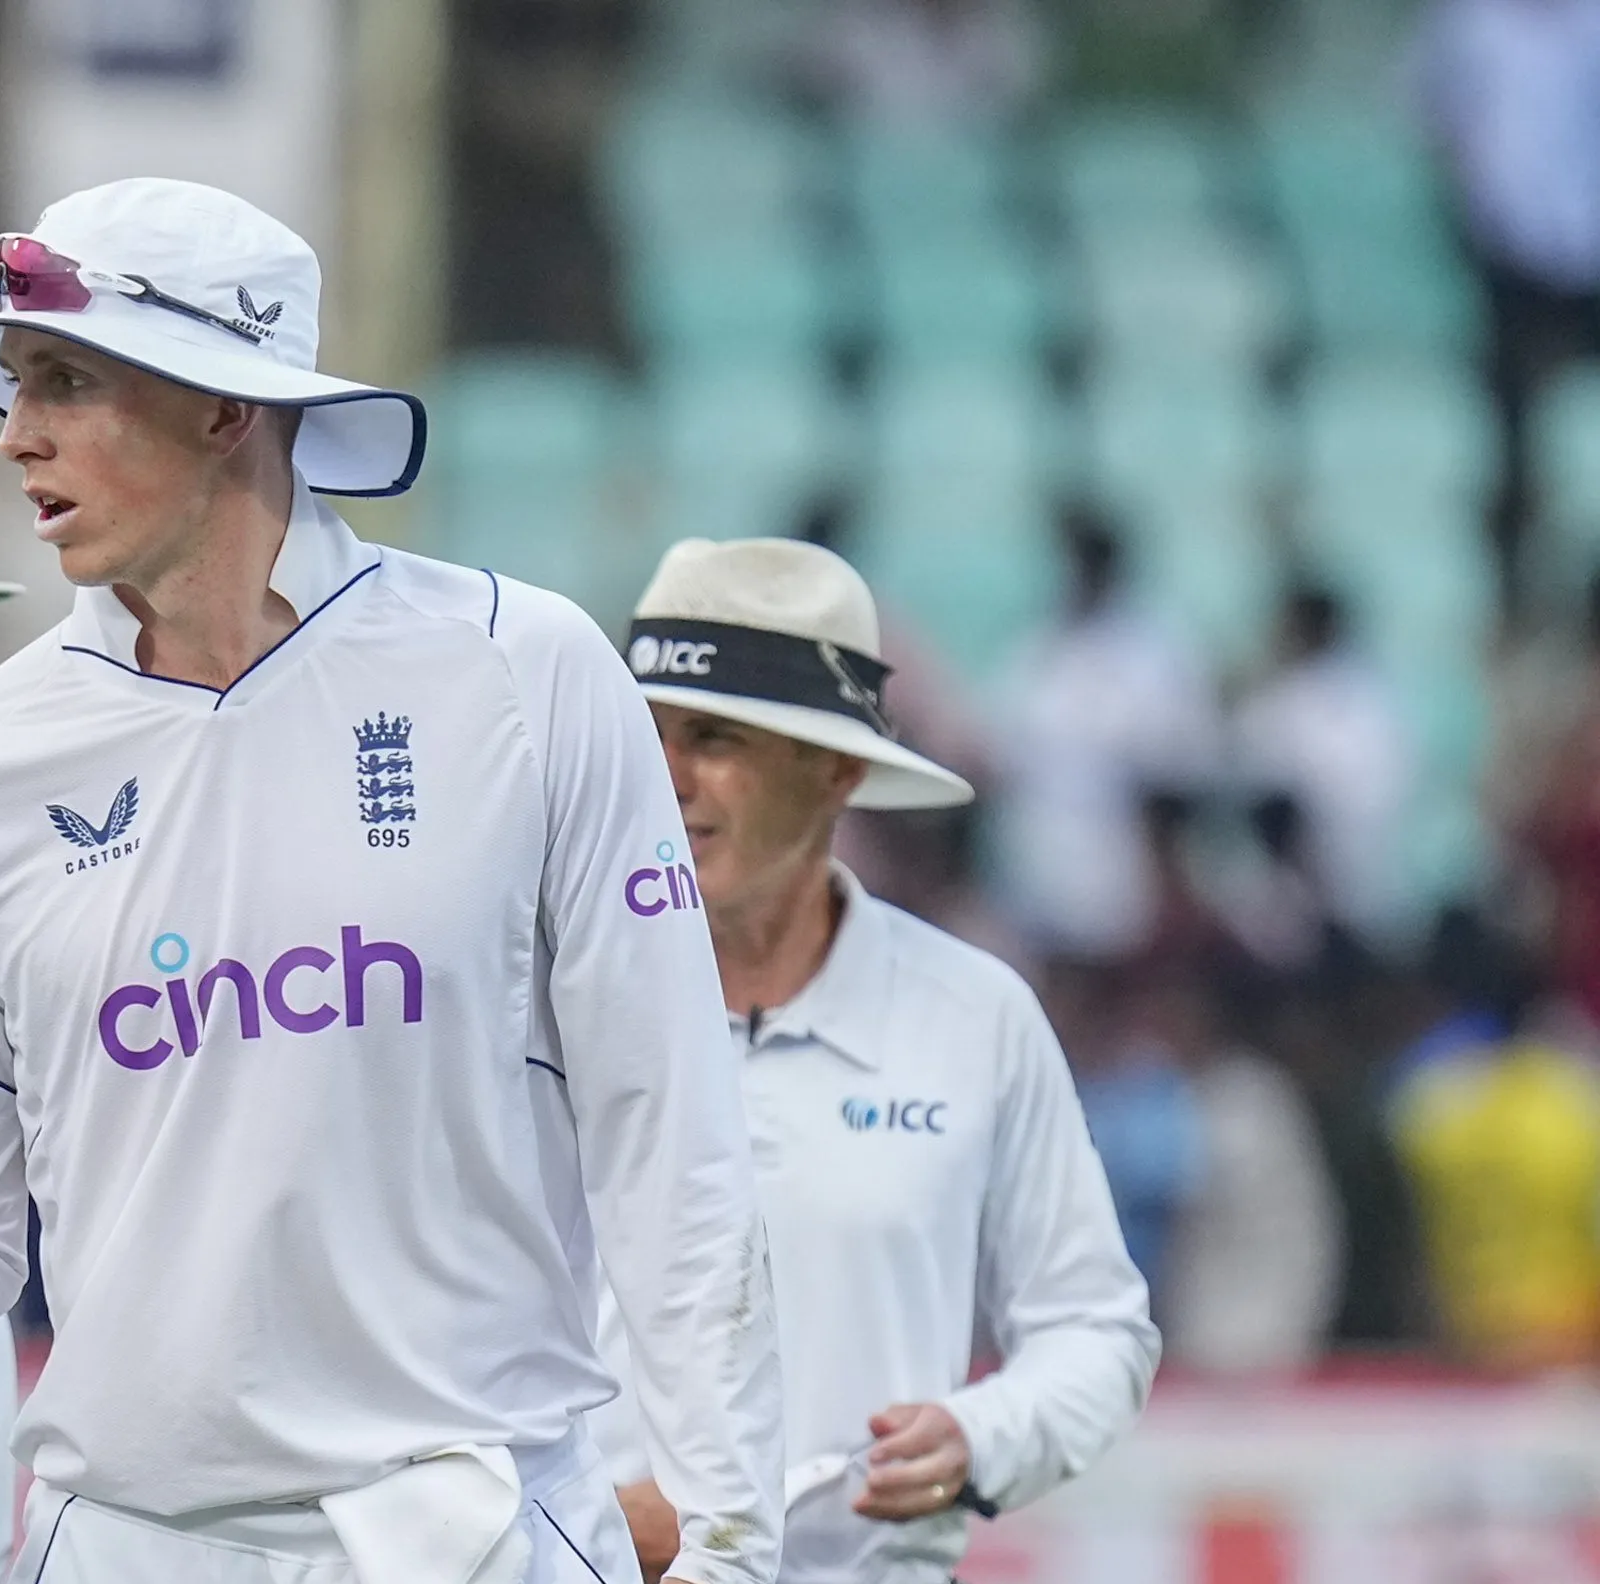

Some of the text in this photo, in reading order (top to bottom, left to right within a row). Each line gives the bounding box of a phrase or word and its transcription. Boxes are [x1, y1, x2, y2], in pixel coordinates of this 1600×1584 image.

[657, 638, 718, 674] ICC
[365, 828, 411, 849] 695
[99, 925, 423, 1071] cinch
[886, 1100, 949, 1134] ICC
